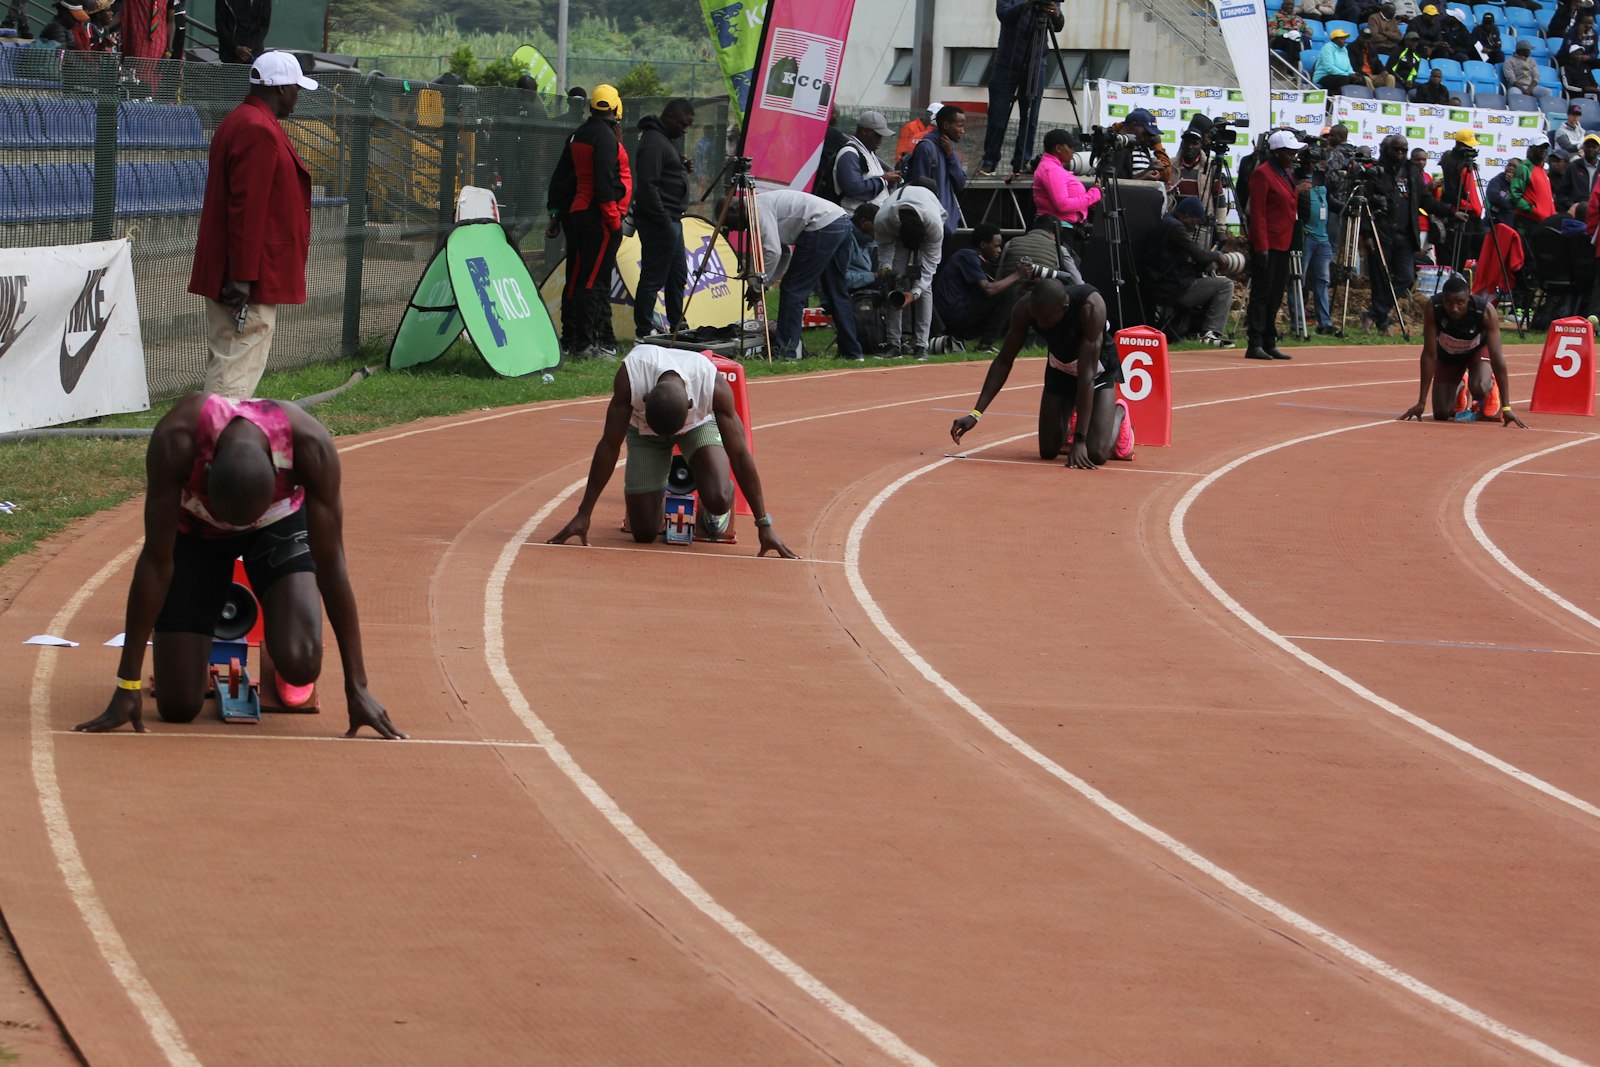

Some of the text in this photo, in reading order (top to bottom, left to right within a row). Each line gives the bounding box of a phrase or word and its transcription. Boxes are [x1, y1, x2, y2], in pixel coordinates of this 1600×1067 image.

[68, 266, 110, 333] NIKE
[493, 278, 532, 320] KCB
[1119, 337, 1160, 347] MONDO
[1554, 325, 1587, 334] MONDO
[1120, 350, 1153, 401] 6
[1552, 336, 1582, 378] 5
